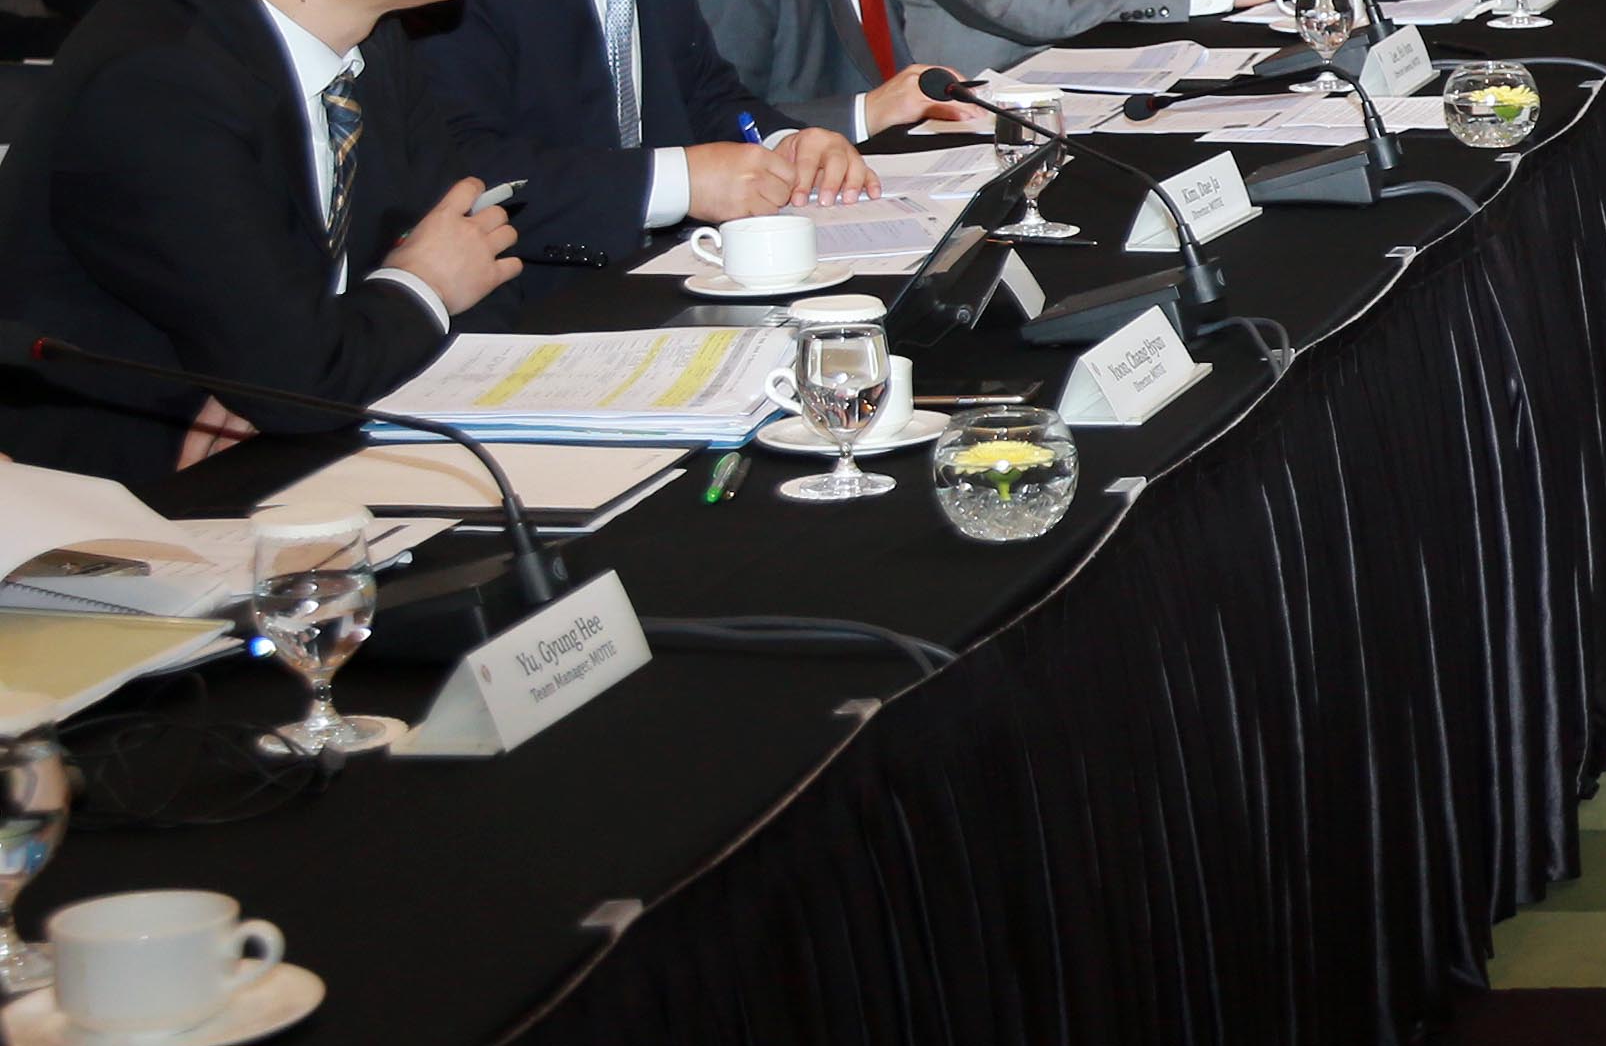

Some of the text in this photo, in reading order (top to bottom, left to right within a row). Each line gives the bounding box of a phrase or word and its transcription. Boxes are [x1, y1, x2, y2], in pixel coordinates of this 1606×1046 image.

[516, 615, 604, 676] Yu, Gyung Hee
[589, 640, 618, 667] MOTIE
